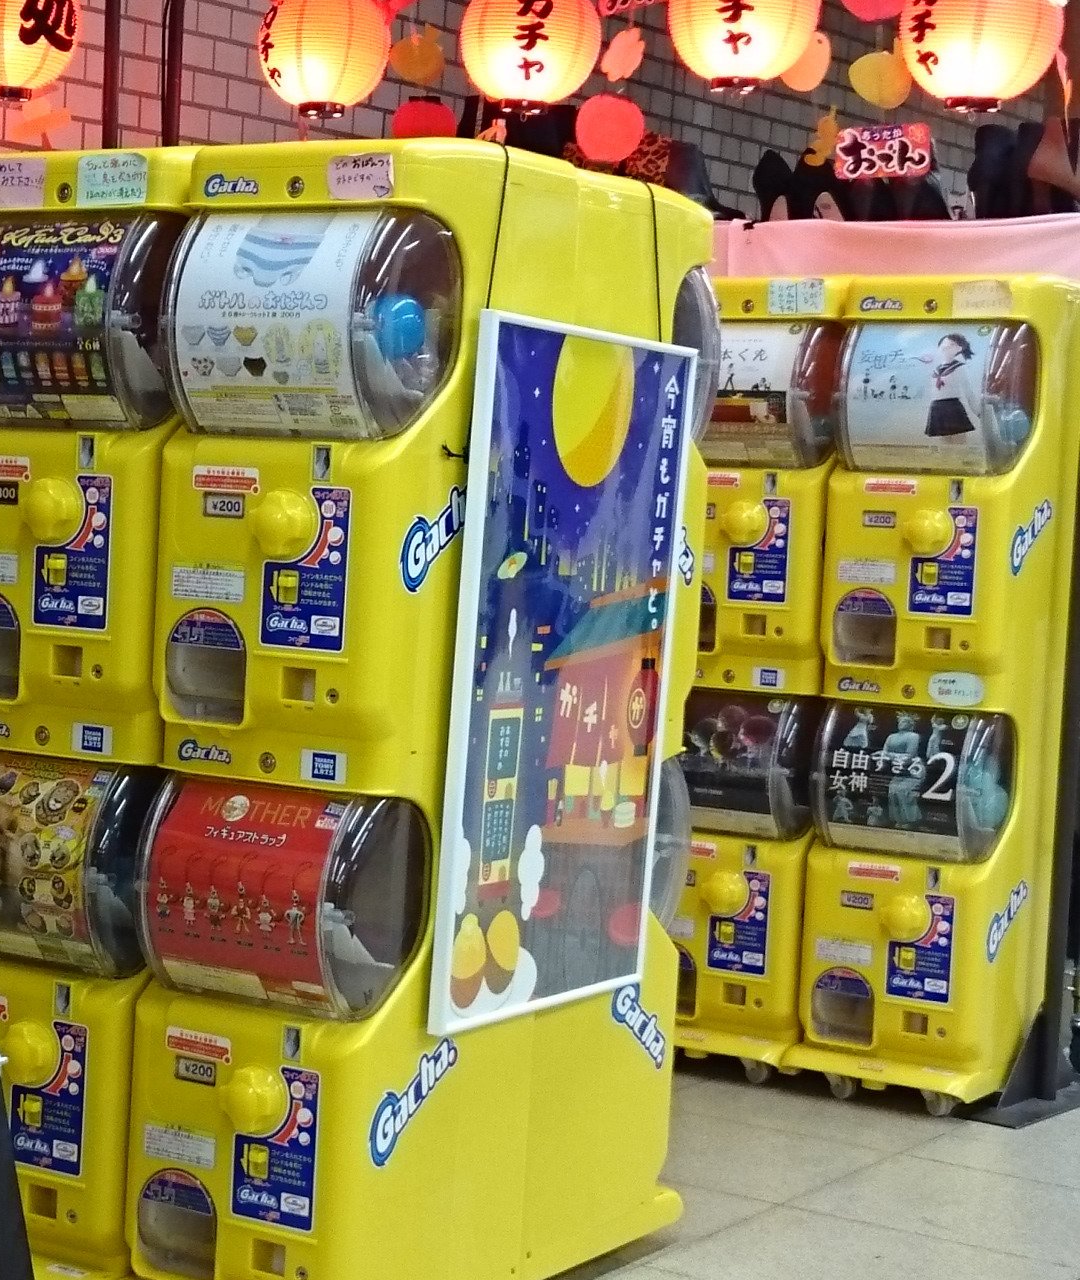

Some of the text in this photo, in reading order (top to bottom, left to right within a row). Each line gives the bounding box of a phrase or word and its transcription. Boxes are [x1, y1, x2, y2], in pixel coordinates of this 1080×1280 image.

[861, 128, 902, 140] あったか
[837, 132, 928, 177] おでん
[211, 499, 241, 513] ¥200
[647, 375, 683, 631] 今宵もガチャと。
[829, 770, 868, 793] 女神
[831, 748, 956, 802] 自由すぎる 2
[201, 794, 312, 830] MOTHER
[204, 824, 288, 848] フィギュアストラップ
[184, 1062, 214, 1079] ¥200
